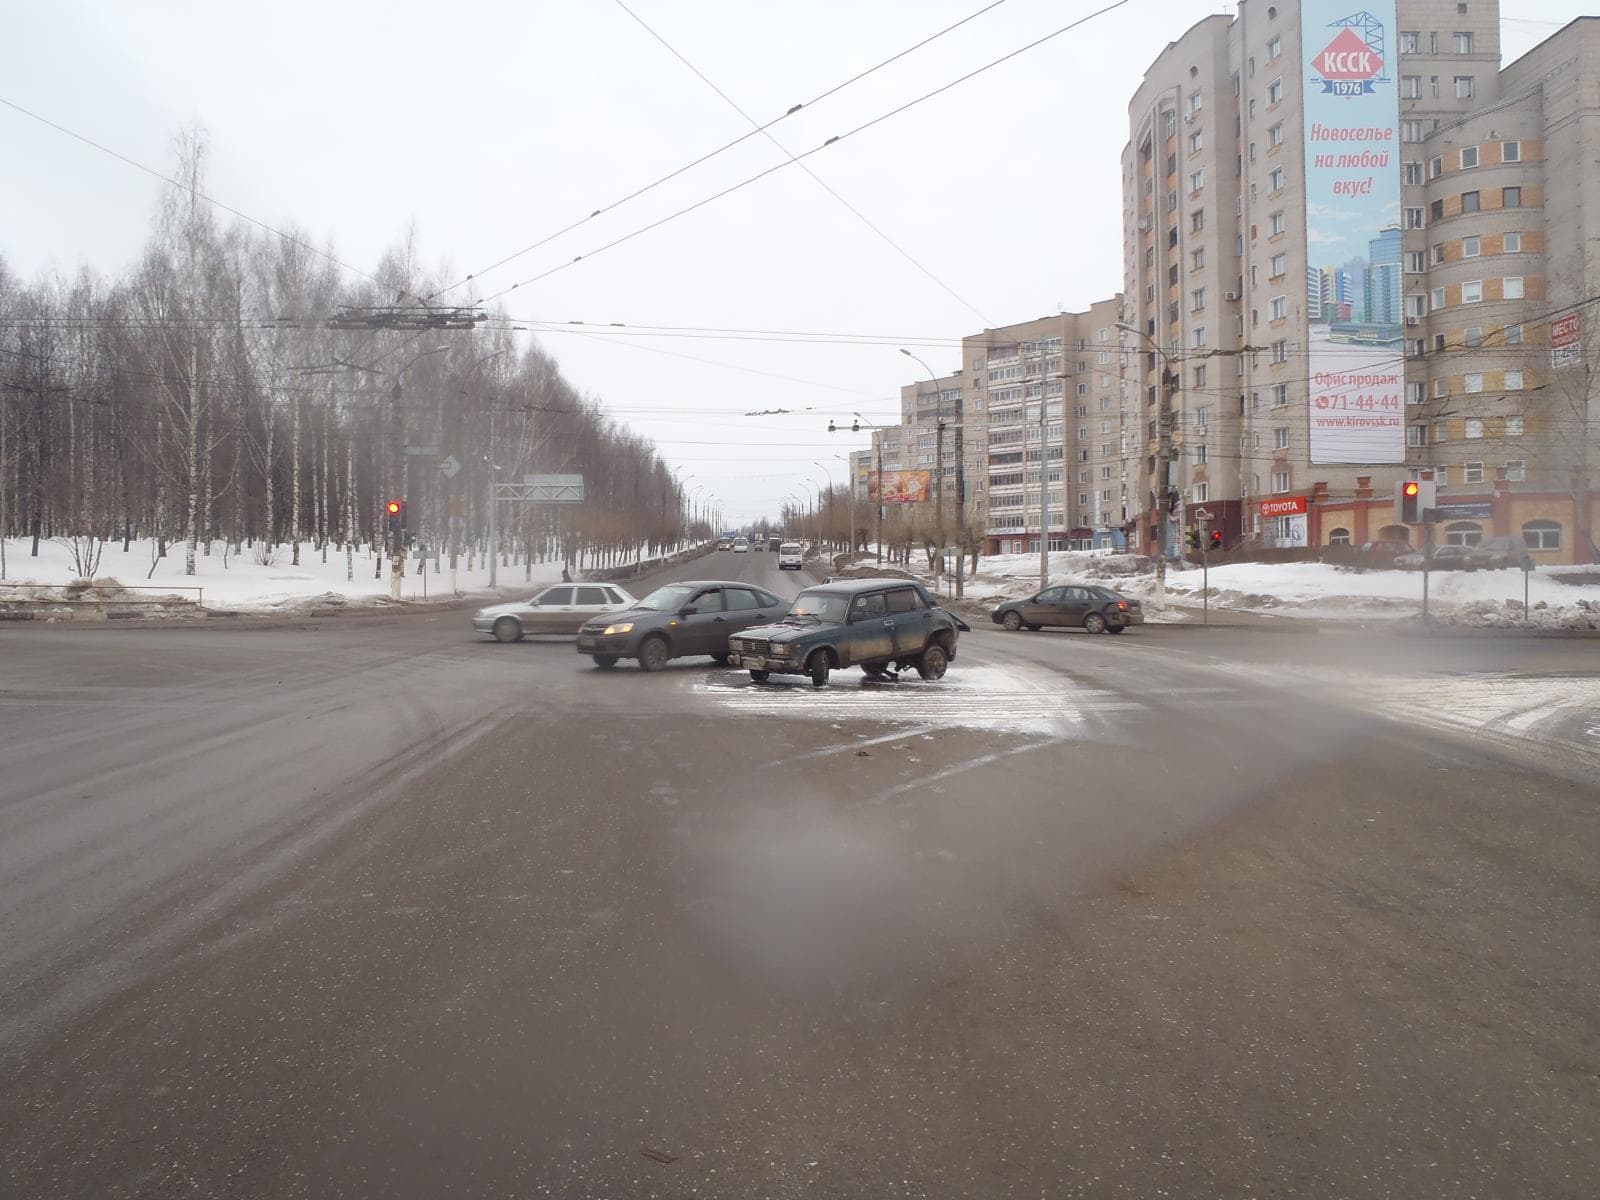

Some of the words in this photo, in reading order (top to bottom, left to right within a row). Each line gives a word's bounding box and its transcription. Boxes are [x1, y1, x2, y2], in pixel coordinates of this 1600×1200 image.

[1324, 52, 1371, 73] КССК
[1334, 82, 1361, 95] 1976
[1310, 123, 1393, 141] Новоселье
[1315, 154, 1333, 168] на
[1336, 150, 1389, 168] любой
[1333, 177, 1372, 198] вкус!
[1315, 371, 1348, 388] Офис
[1349, 373, 1398, 389] продаж
[1330, 394, 1400, 410] 71-44-44
[1270, 501, 1298, 512] TOYOTA
